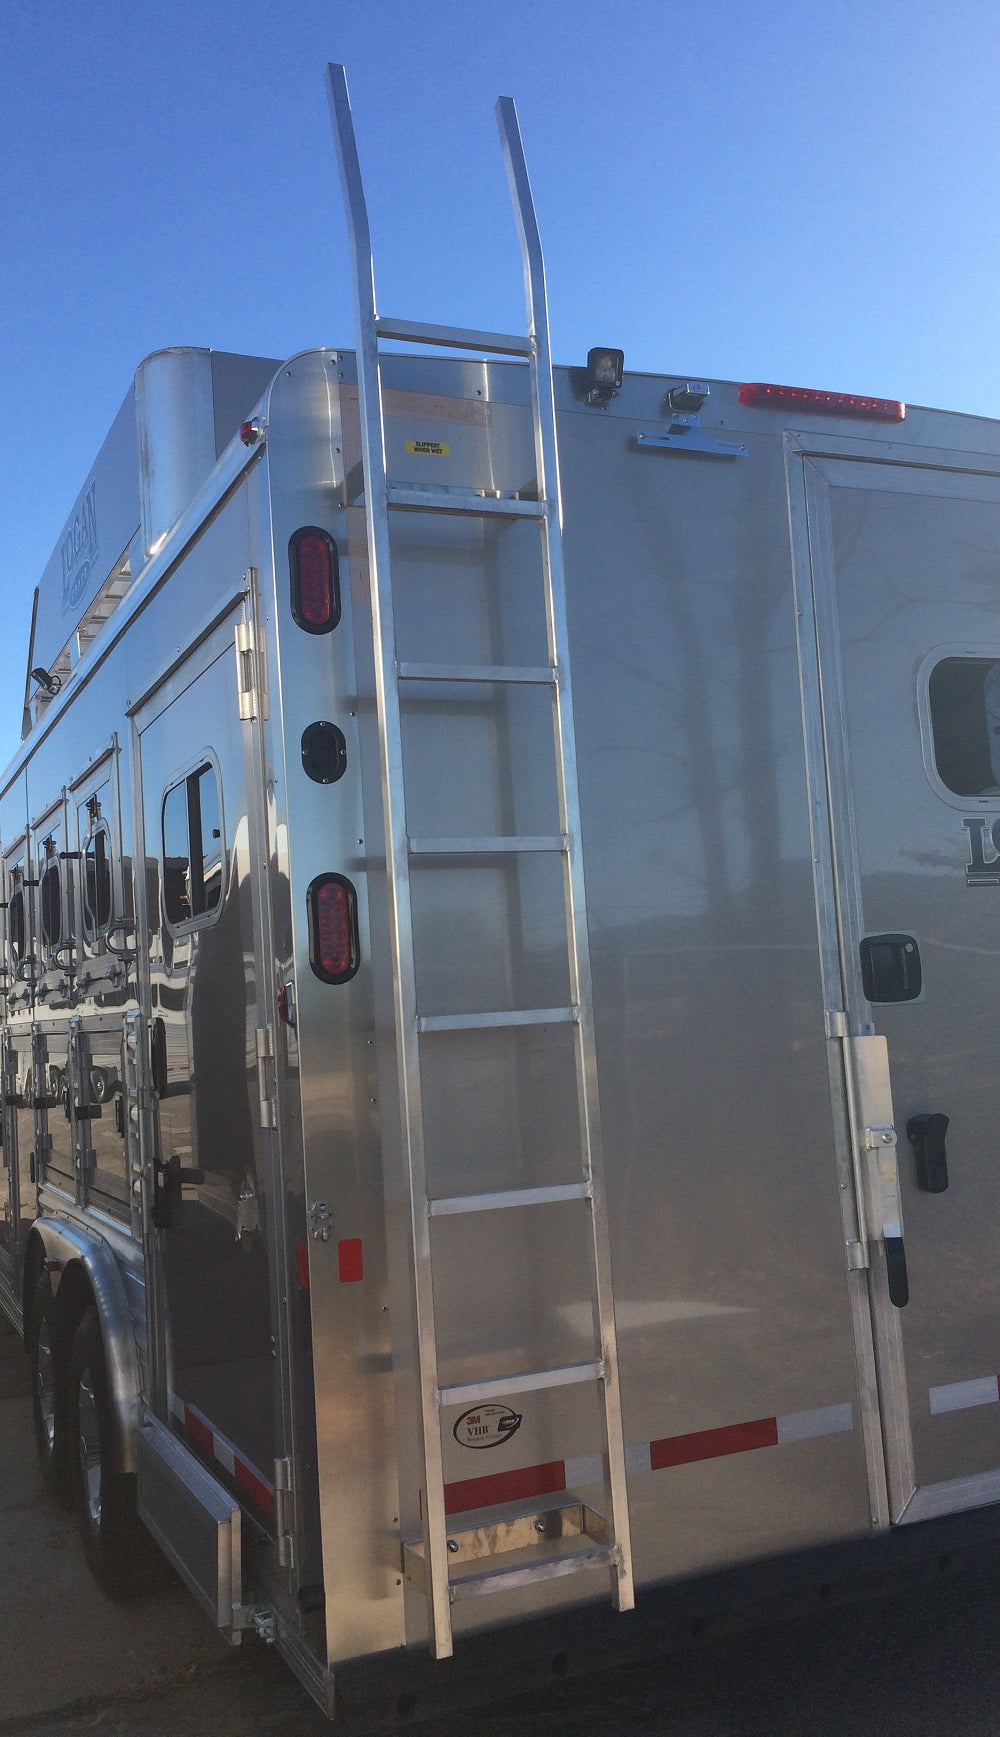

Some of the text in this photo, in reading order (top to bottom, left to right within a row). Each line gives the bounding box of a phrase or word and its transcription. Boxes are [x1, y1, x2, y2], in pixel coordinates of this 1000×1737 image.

[60, 477, 98, 604] LOGAN
[466, 1415, 480, 1425] 3M
[467, 1425, 488, 1436] VHB
